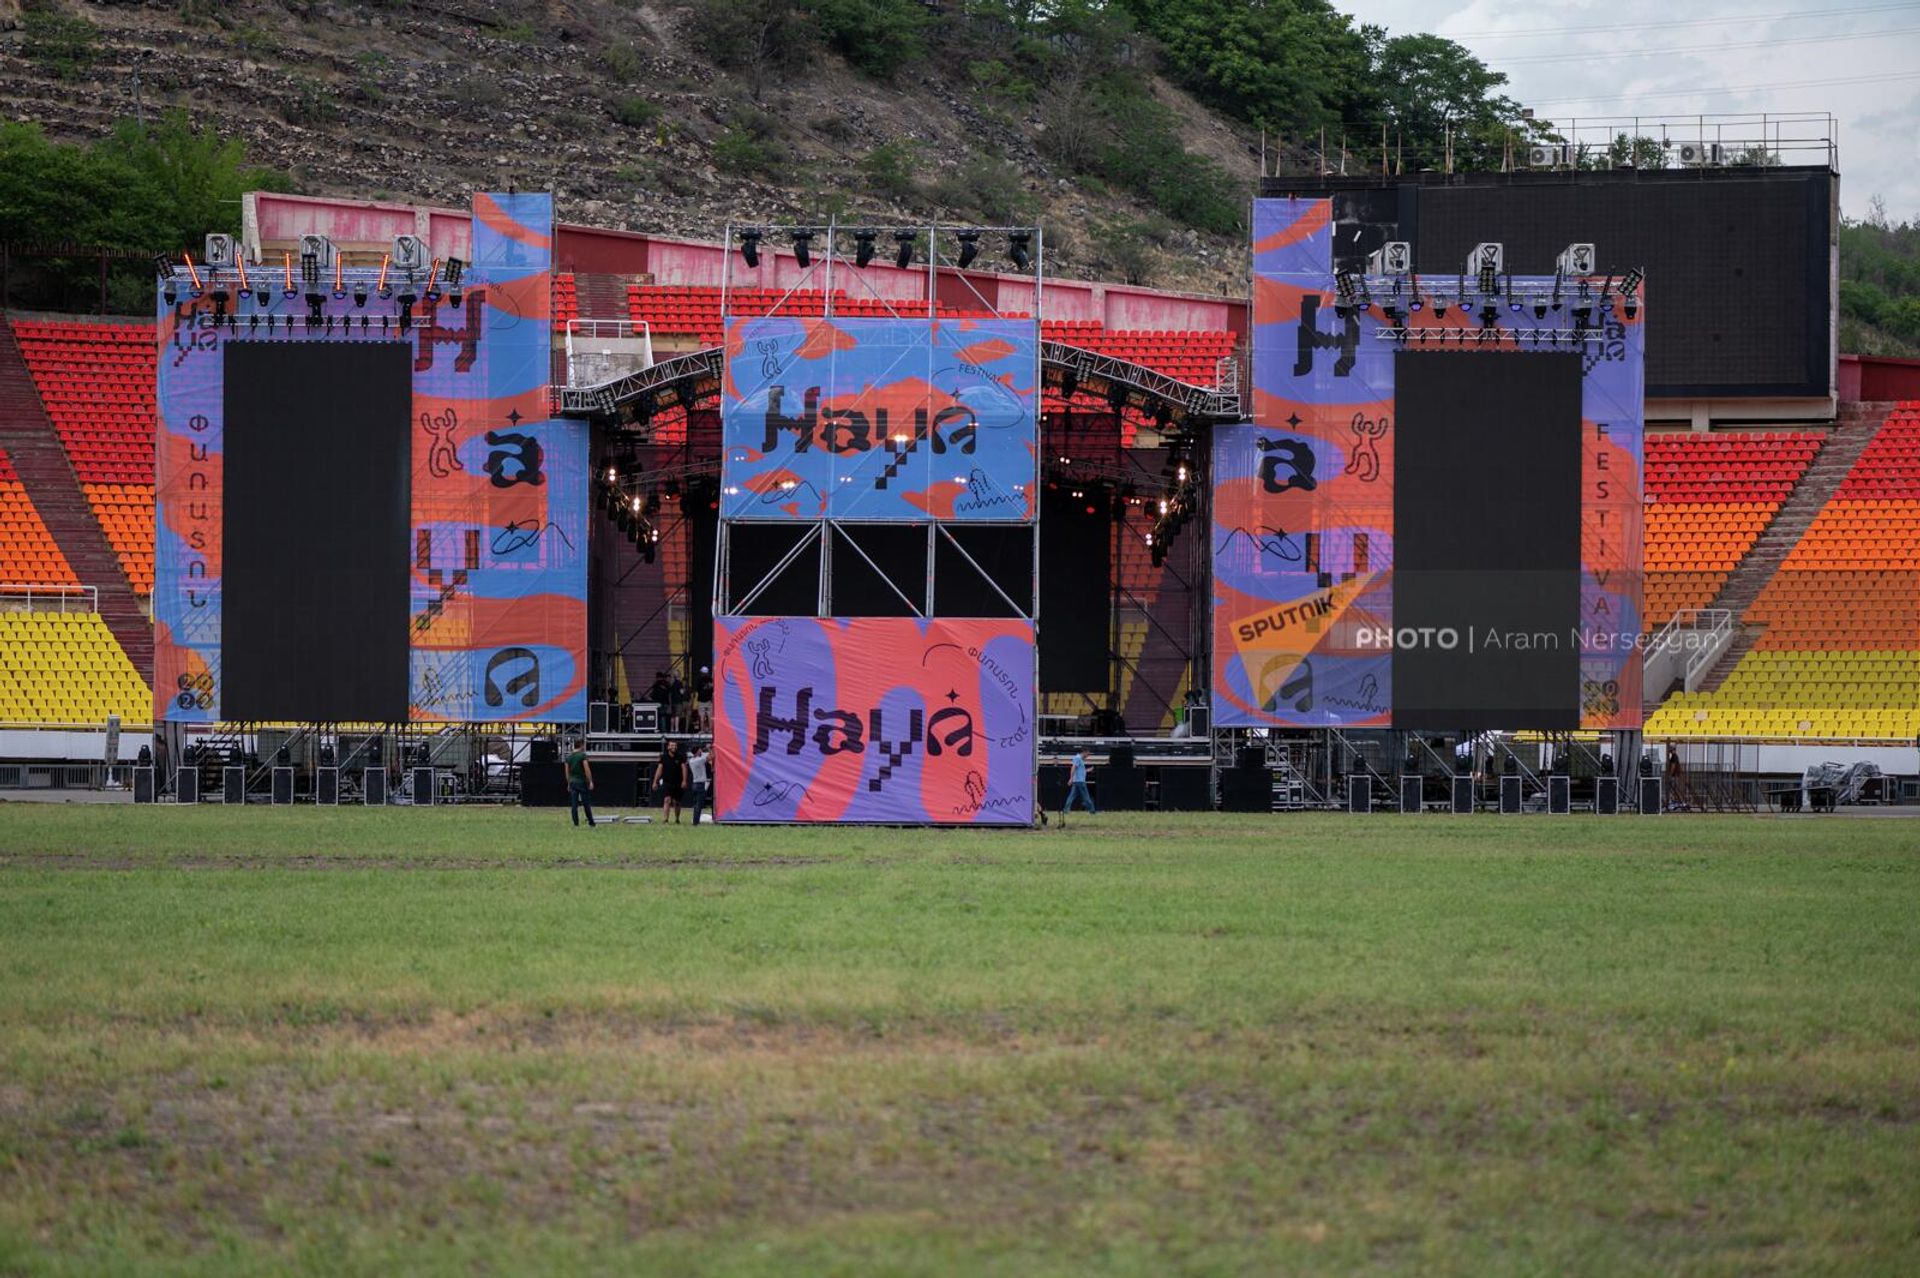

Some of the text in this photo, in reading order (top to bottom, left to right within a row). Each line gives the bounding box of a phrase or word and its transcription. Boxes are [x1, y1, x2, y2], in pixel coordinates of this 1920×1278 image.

[762, 386, 976, 490] Haya
[753, 687, 973, 792] Haya
[1000, 727, 1028, 749] 2022
